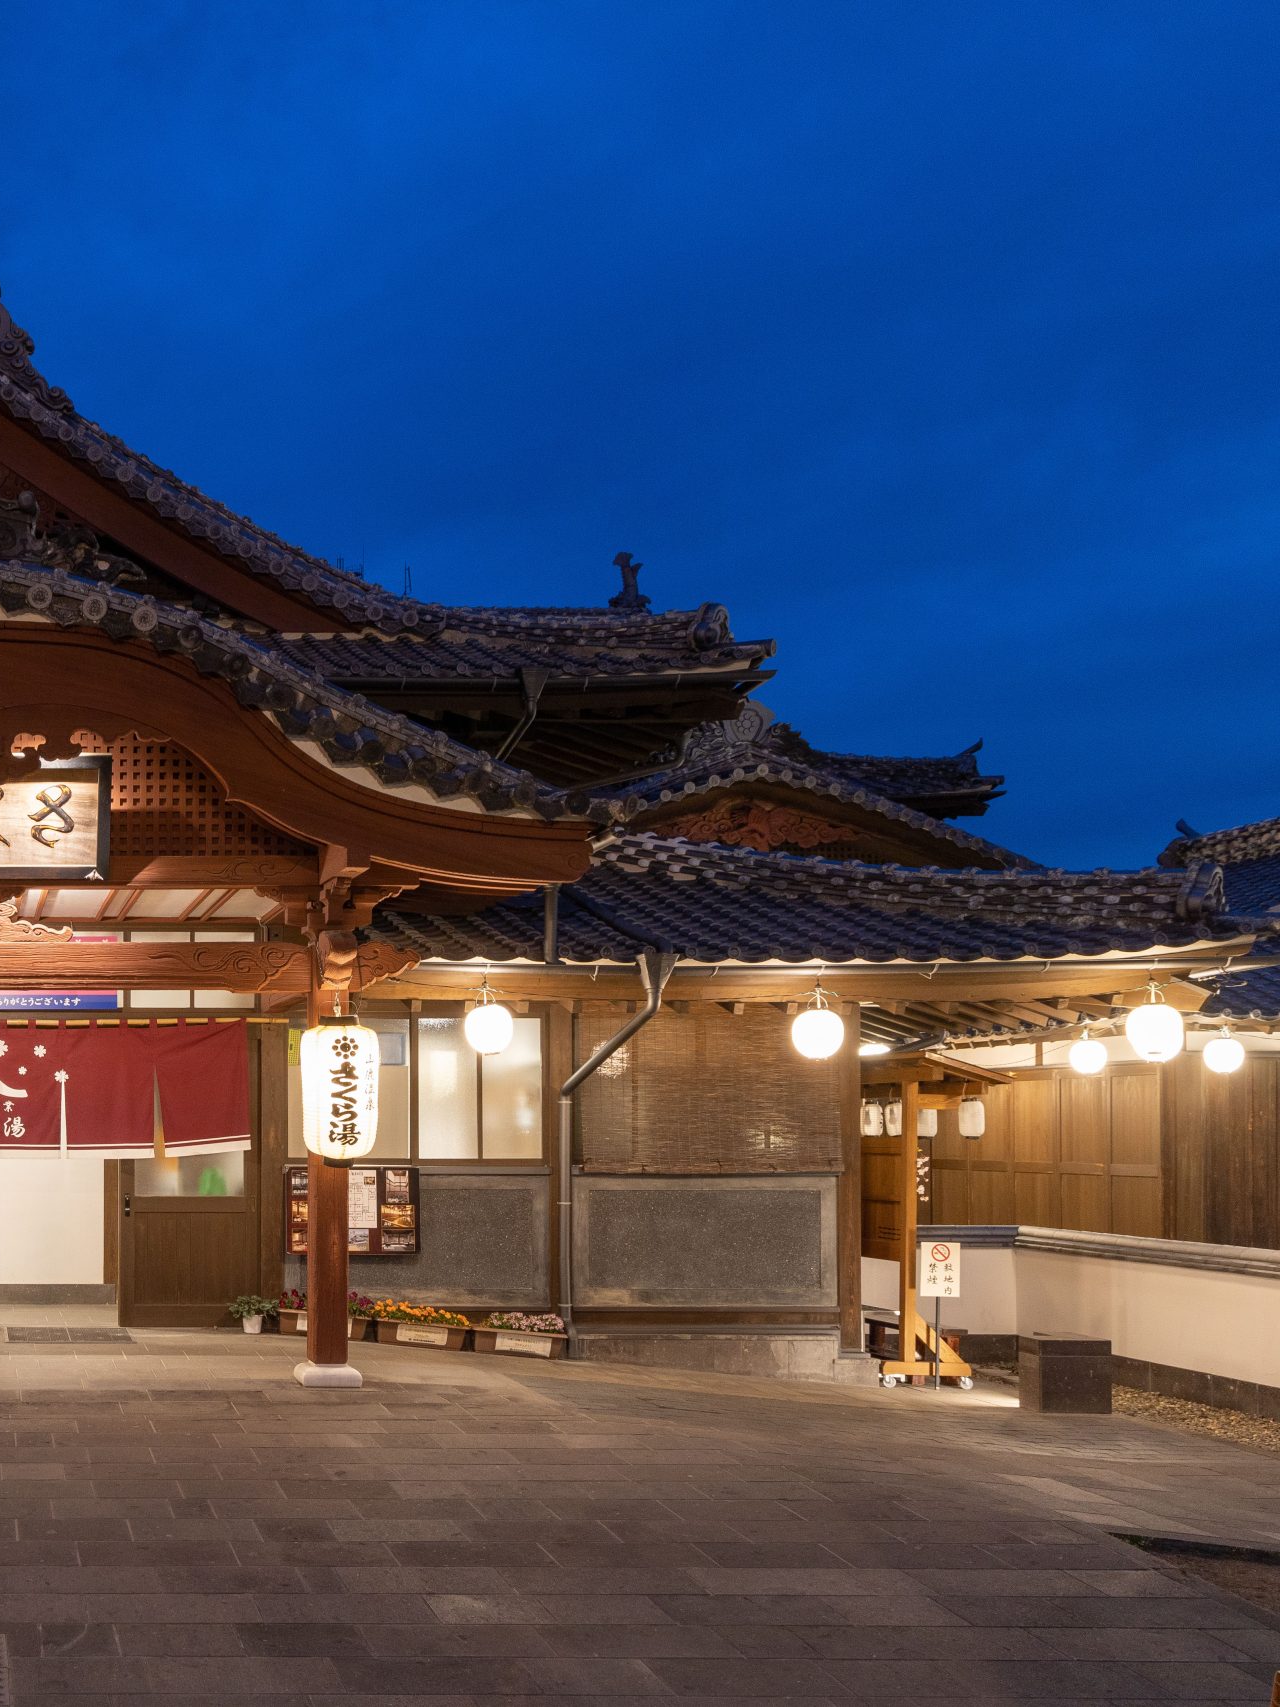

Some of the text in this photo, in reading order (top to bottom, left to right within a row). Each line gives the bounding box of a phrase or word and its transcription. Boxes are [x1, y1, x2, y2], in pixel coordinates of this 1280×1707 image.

[328, 1061, 362, 1146] さくら湯
[927, 1262, 938, 1285] 禁煙
[943, 1262, 954, 1295] 敷地内
